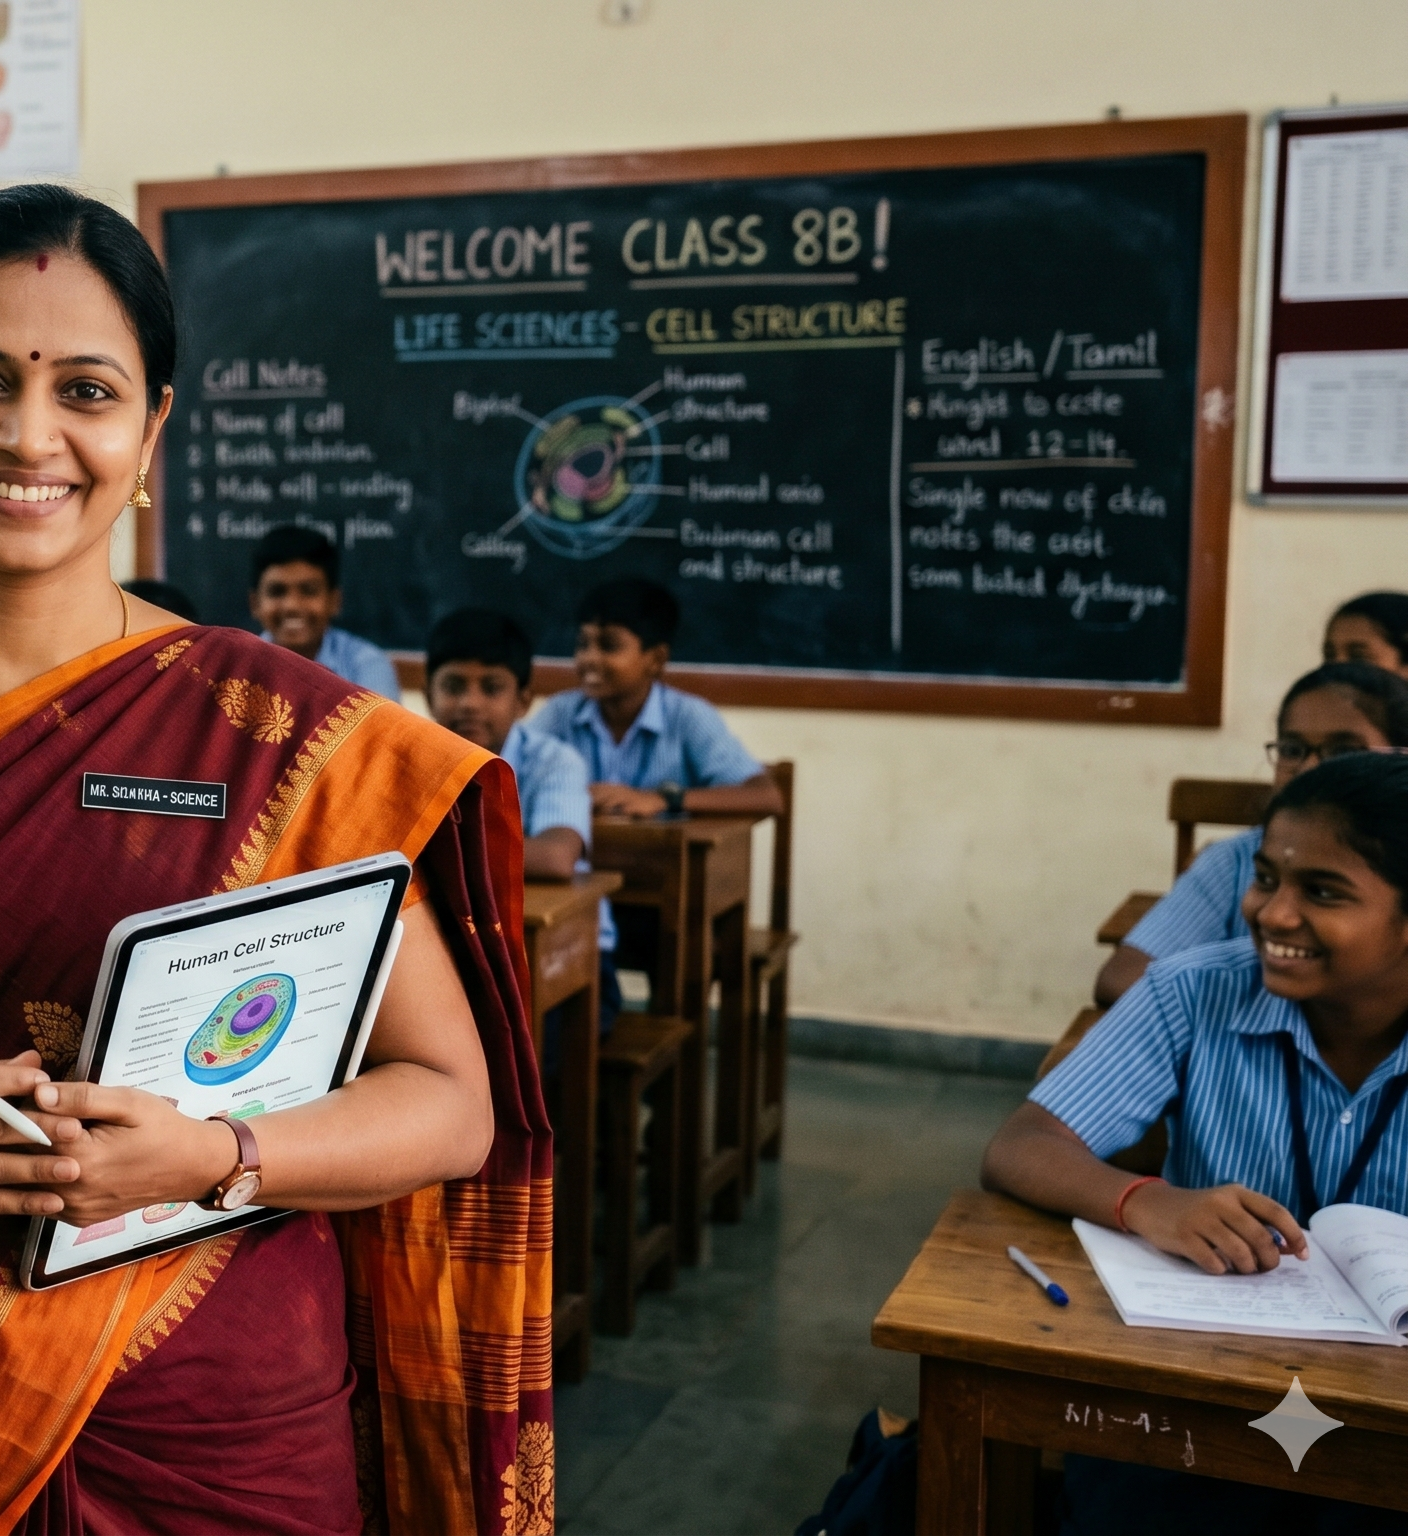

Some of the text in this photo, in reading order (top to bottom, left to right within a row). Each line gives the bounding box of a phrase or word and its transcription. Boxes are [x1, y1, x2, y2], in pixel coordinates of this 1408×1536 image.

[375, 197, 891, 285] WELCOME CLASS 8B!
[395, 311, 462, 350] LIFE
[475, 309, 620, 348] SCIENCES
[646, 307, 719, 343] CELL
[731, 298, 908, 340] STRUCTURE
[663, 366, 747, 392] Human
[922, 336, 1035, 391] English
[1065, 329, 1158, 370] Tamil
[671, 396, 771, 423] structure
[1062, 482, 1097, 522] of
[679, 552, 844, 590] and structure
[90, 783, 109, 798] MR.
[170, 791, 219, 807] SCIENCE
[168, 949, 228, 975] Human
[233, 937, 266, 958] Cell
[269, 920, 346, 949] Structure
